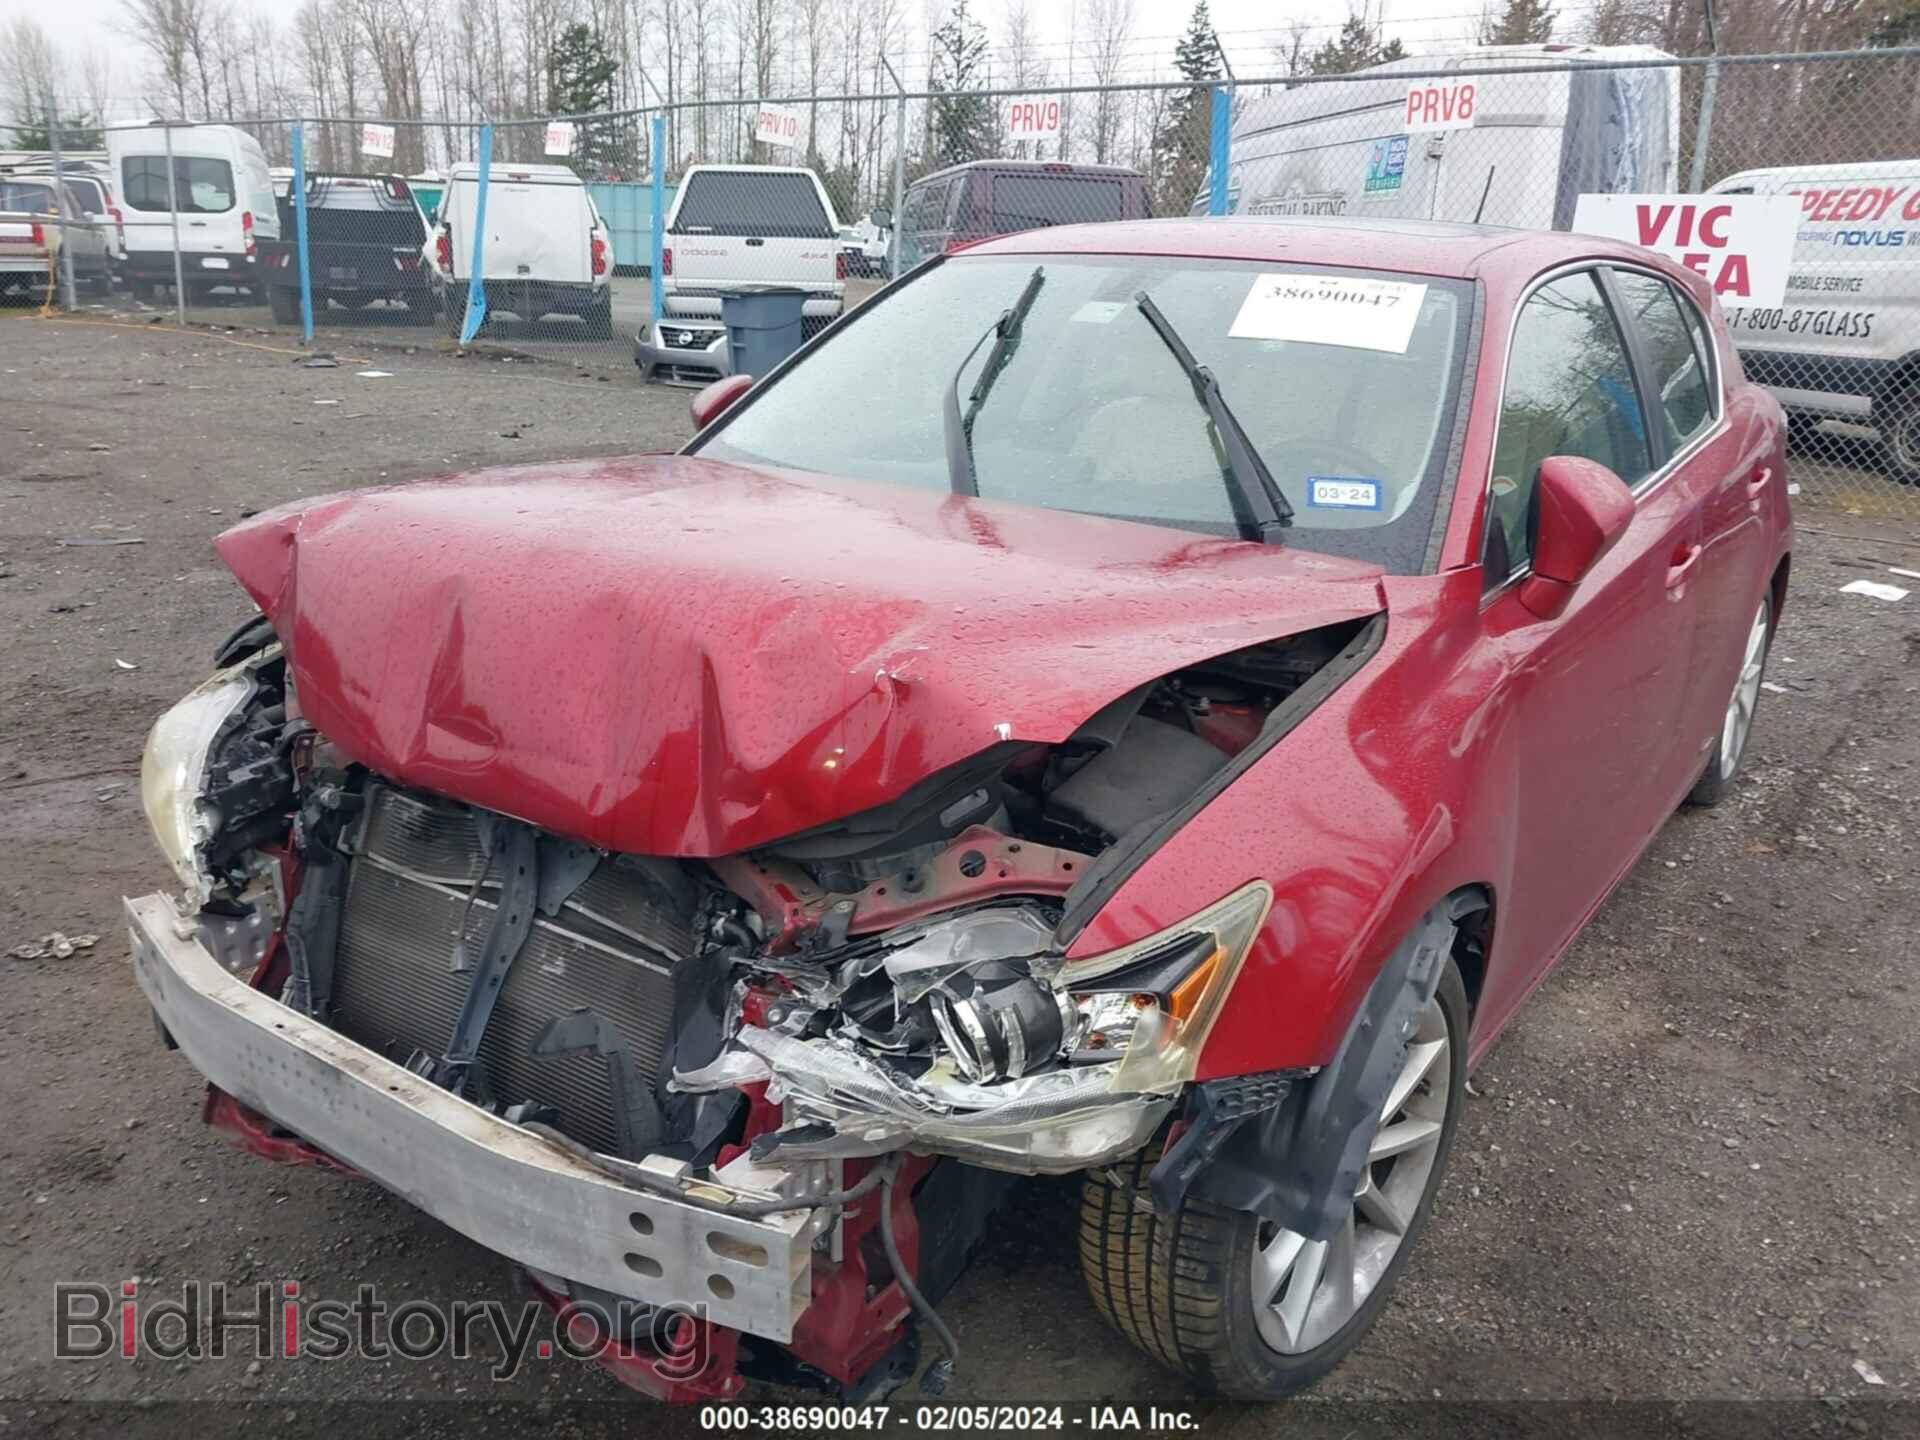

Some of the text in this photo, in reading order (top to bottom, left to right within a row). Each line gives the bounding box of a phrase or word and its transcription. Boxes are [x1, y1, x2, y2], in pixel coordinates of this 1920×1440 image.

[1010, 102, 1058, 132] PRV9
[1406, 84, 1475, 125] PRV8
[757, 111, 797, 137] PRV10
[1788, 185, 1909, 221] PEEDY
[1636, 204, 1733, 248] VIC
[1266, 286, 1401, 308] 38690047
[1786, 275, 1863, 292] MOBILE SERVICE
